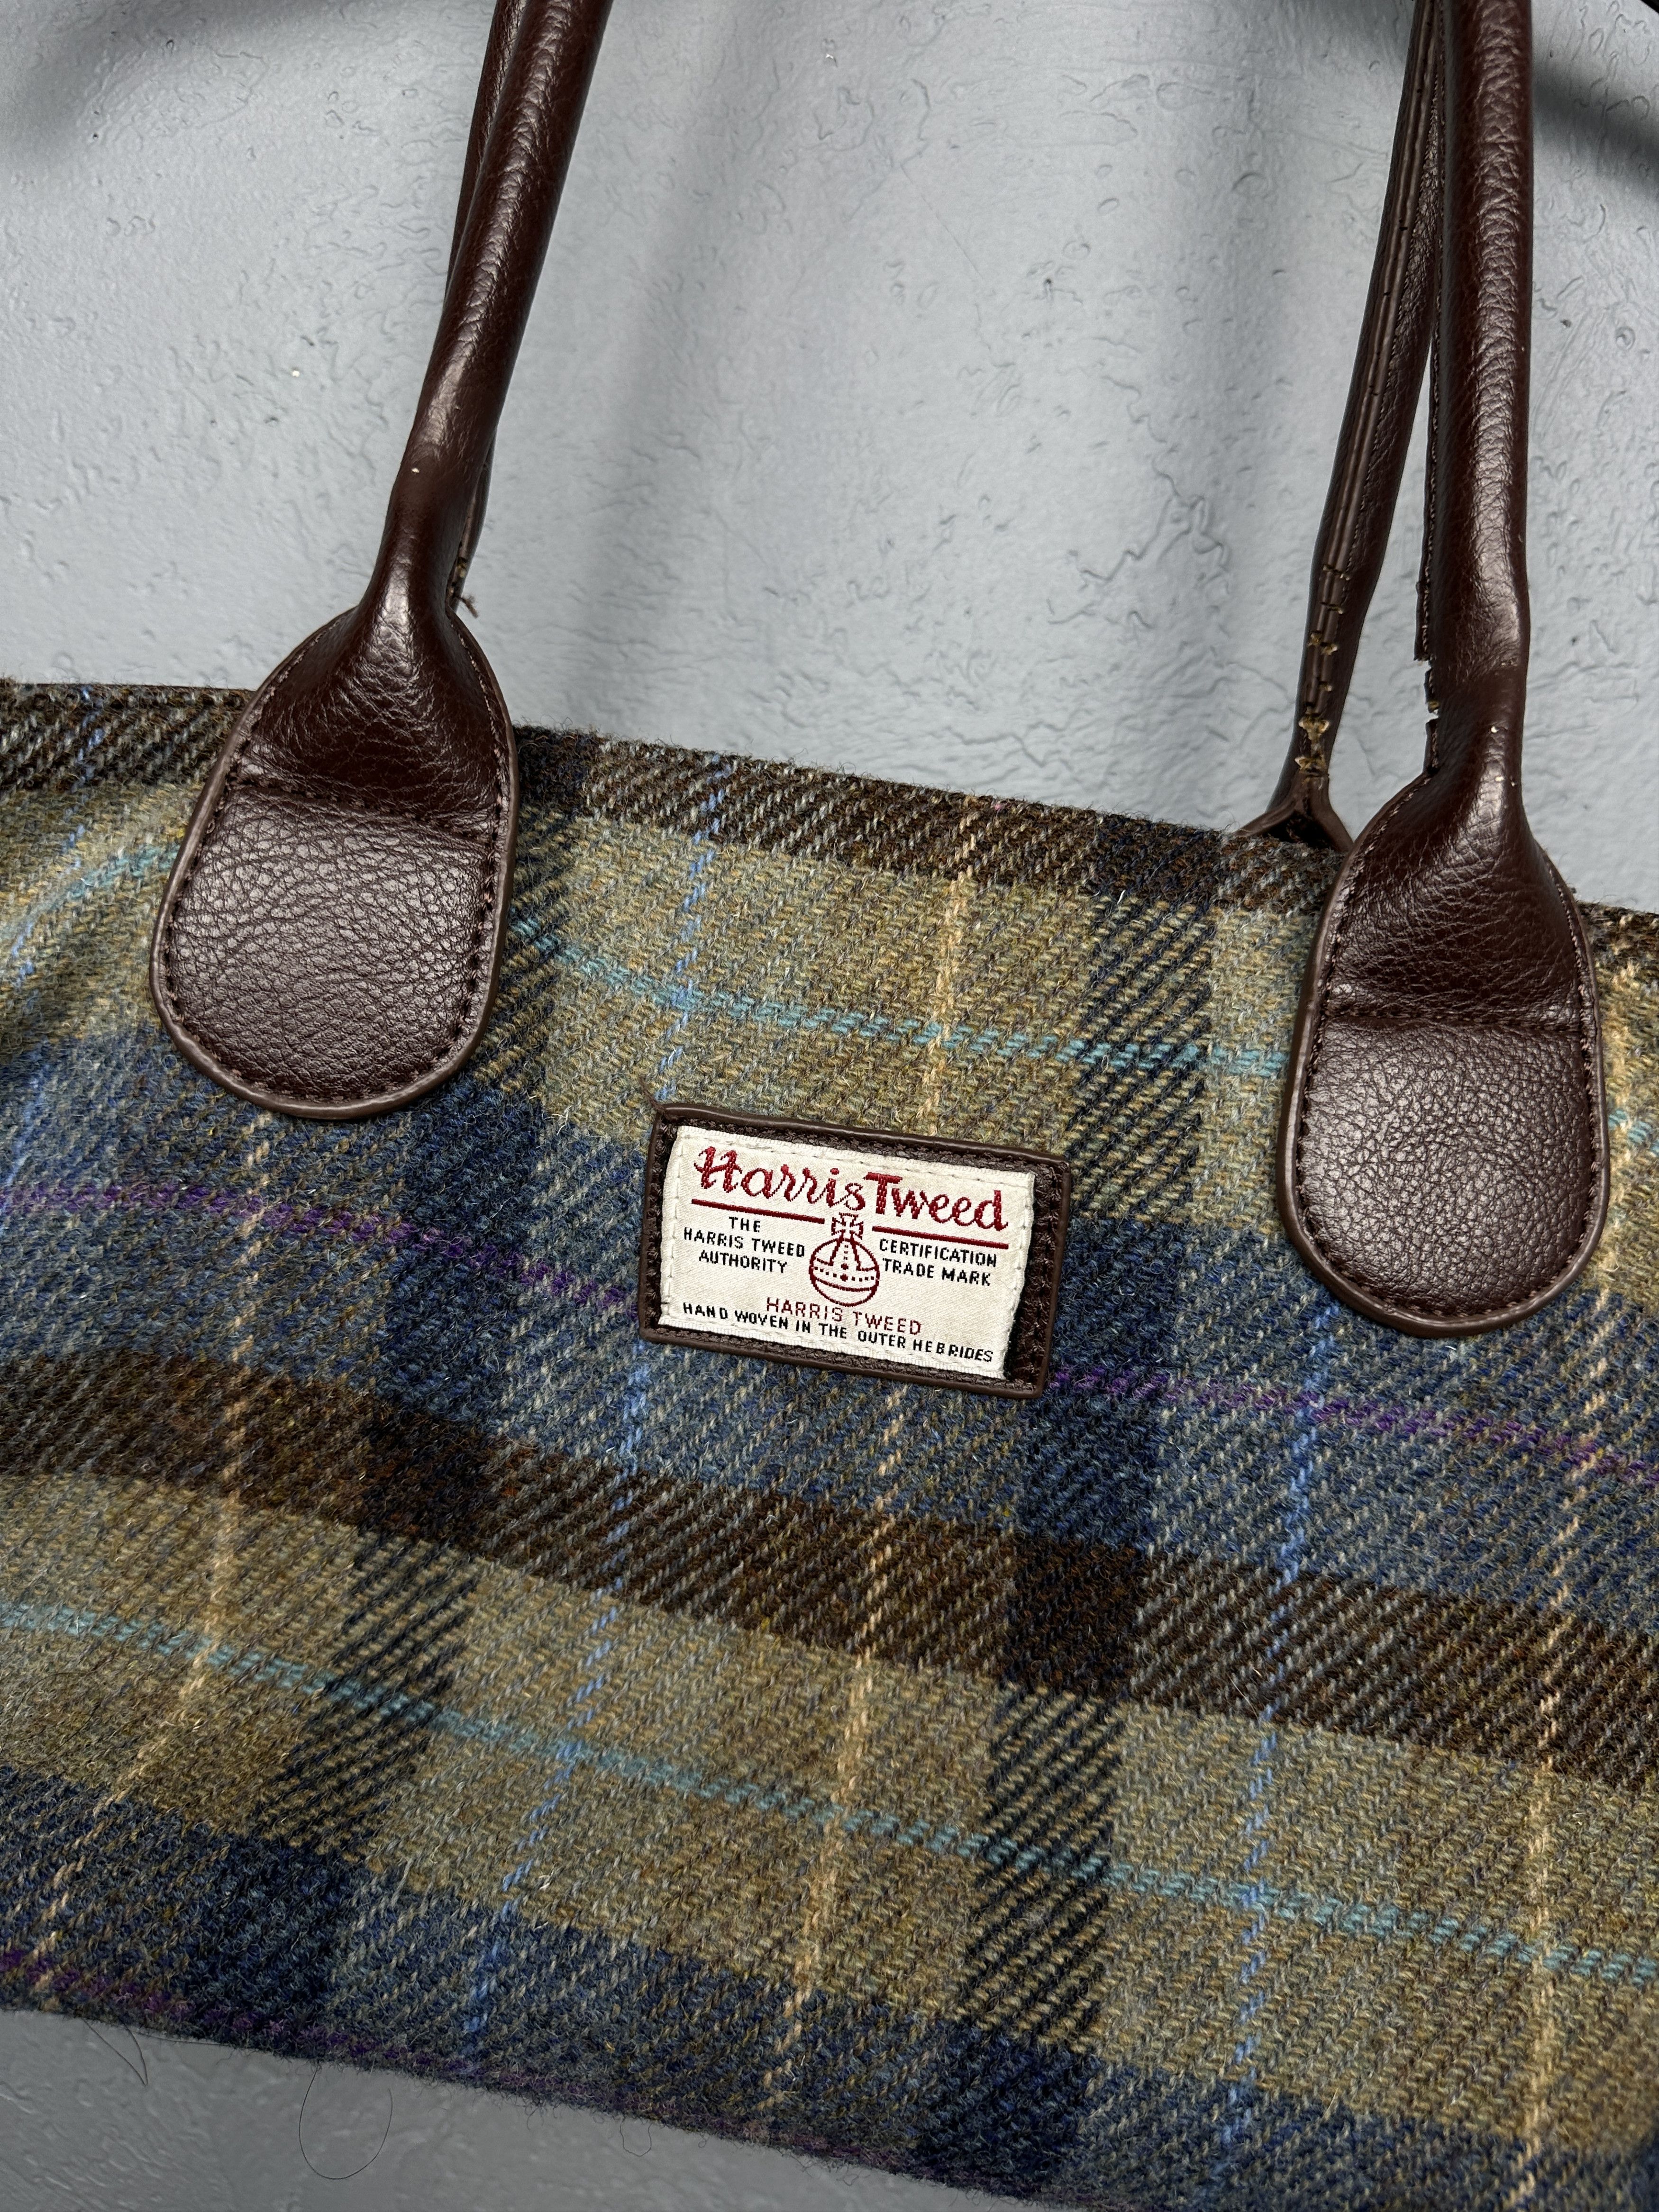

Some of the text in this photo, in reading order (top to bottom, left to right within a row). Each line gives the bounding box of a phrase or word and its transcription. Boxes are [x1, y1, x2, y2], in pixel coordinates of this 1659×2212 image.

[693, 1146, 1009, 1231] Harris Tweed
[729, 1216, 761, 1233] THE
[684, 1227, 806, 1258] HARRIS TWEED
[879, 1238, 997, 1268] CERTIFICATION
[698, 1250, 788, 1274] AUTHORITY
[882, 1258, 991, 1287] TRADE MARK
[766, 1296, 921, 1336] HARRIS TWEED
[683, 1302, 994, 1363] HAND WOVEN IN THE OUTER HEBRIDES
